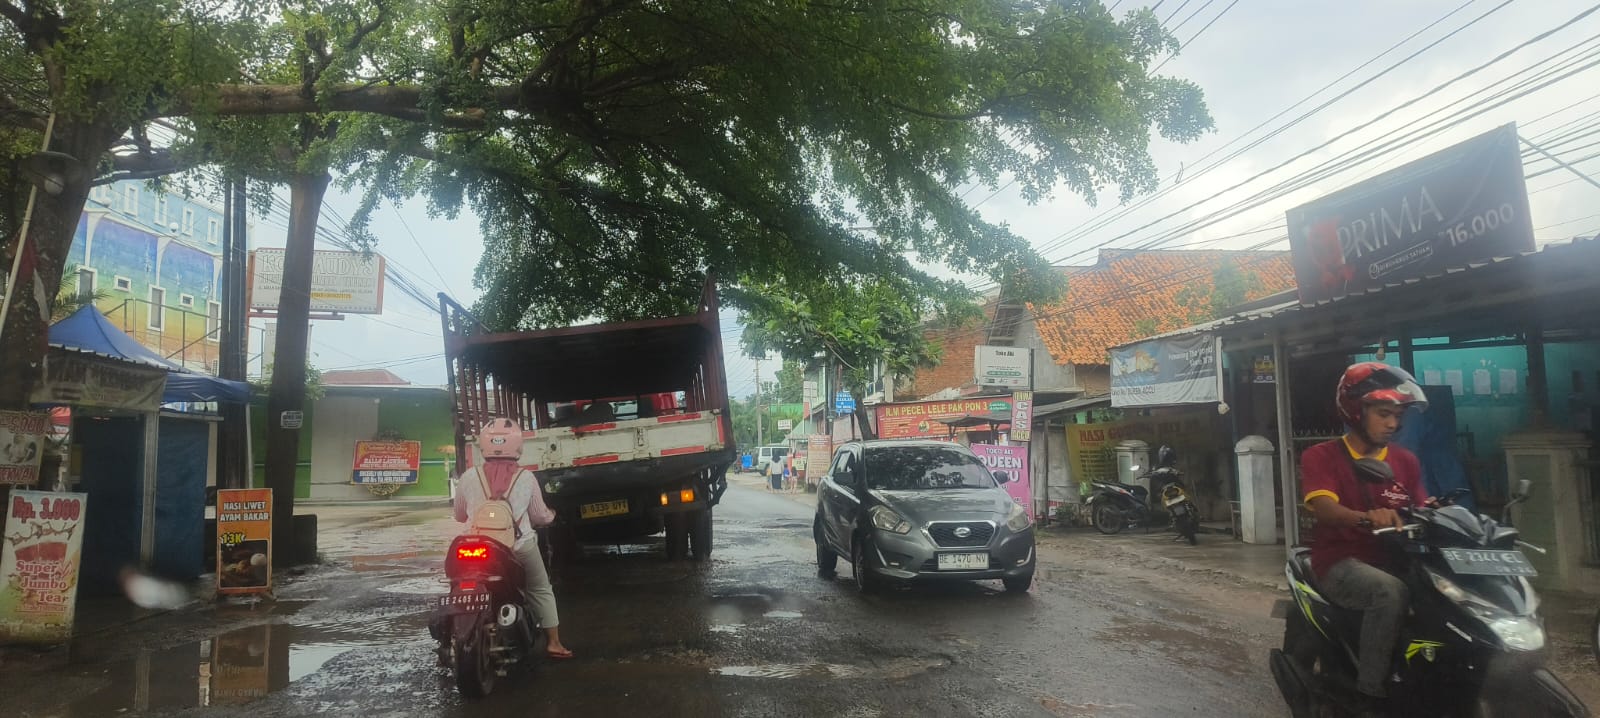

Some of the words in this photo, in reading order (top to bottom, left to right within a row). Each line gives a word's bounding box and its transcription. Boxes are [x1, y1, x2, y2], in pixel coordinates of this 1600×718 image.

[1336, 184, 1444, 259] PRIMA
[1447, 203, 1515, 247] 16.000
[901, 406, 926, 416] PECEL
[927, 404, 947, 414] LELE
[965, 403, 981, 412] PON
[224, 502, 241, 510] NASI
[243, 501, 266, 510] LIWET
[220, 513, 241, 521] AYAM
[243, 512, 269, 521] BAKAR
[223, 533, 242, 544] 13K
[1443, 550, 1464, 561] BE
[15, 560, 58, 575] Super
[20, 577, 68, 590] Jumbo
